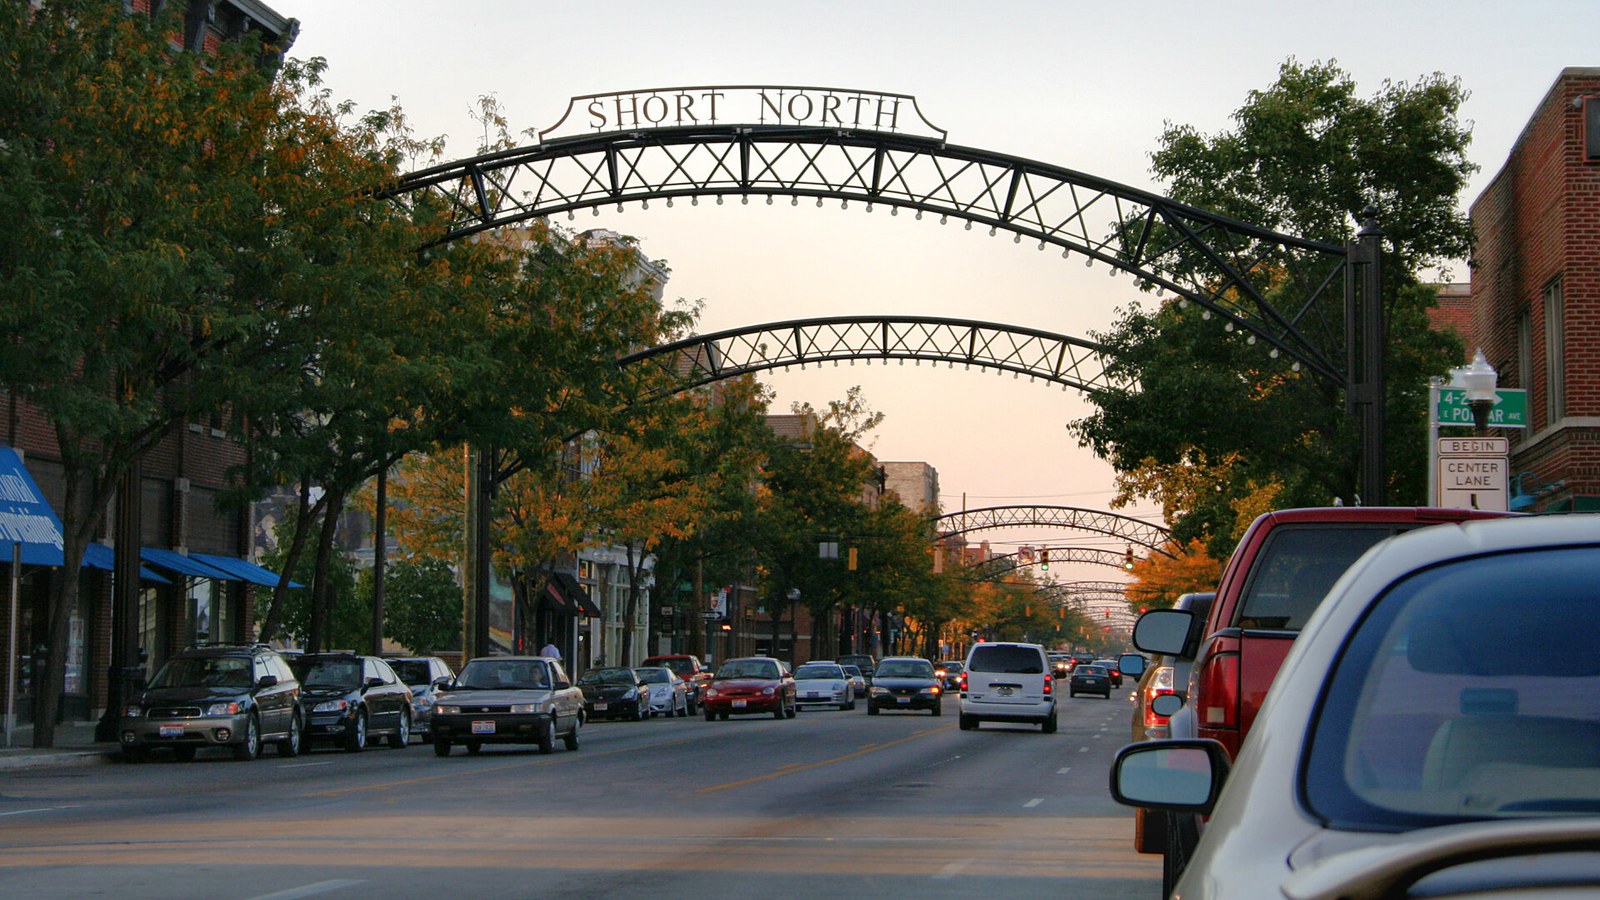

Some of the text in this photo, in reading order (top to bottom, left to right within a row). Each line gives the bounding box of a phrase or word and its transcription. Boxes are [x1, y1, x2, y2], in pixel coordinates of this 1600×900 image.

[588, 92, 902, 129] SHORT NORTH
[1444, 408, 1521, 422] E POAR AVE
[1452, 441, 1495, 452] BEGIN
[1448, 463, 1499, 473] CENTER
[1456, 476, 1492, 486] LANE
